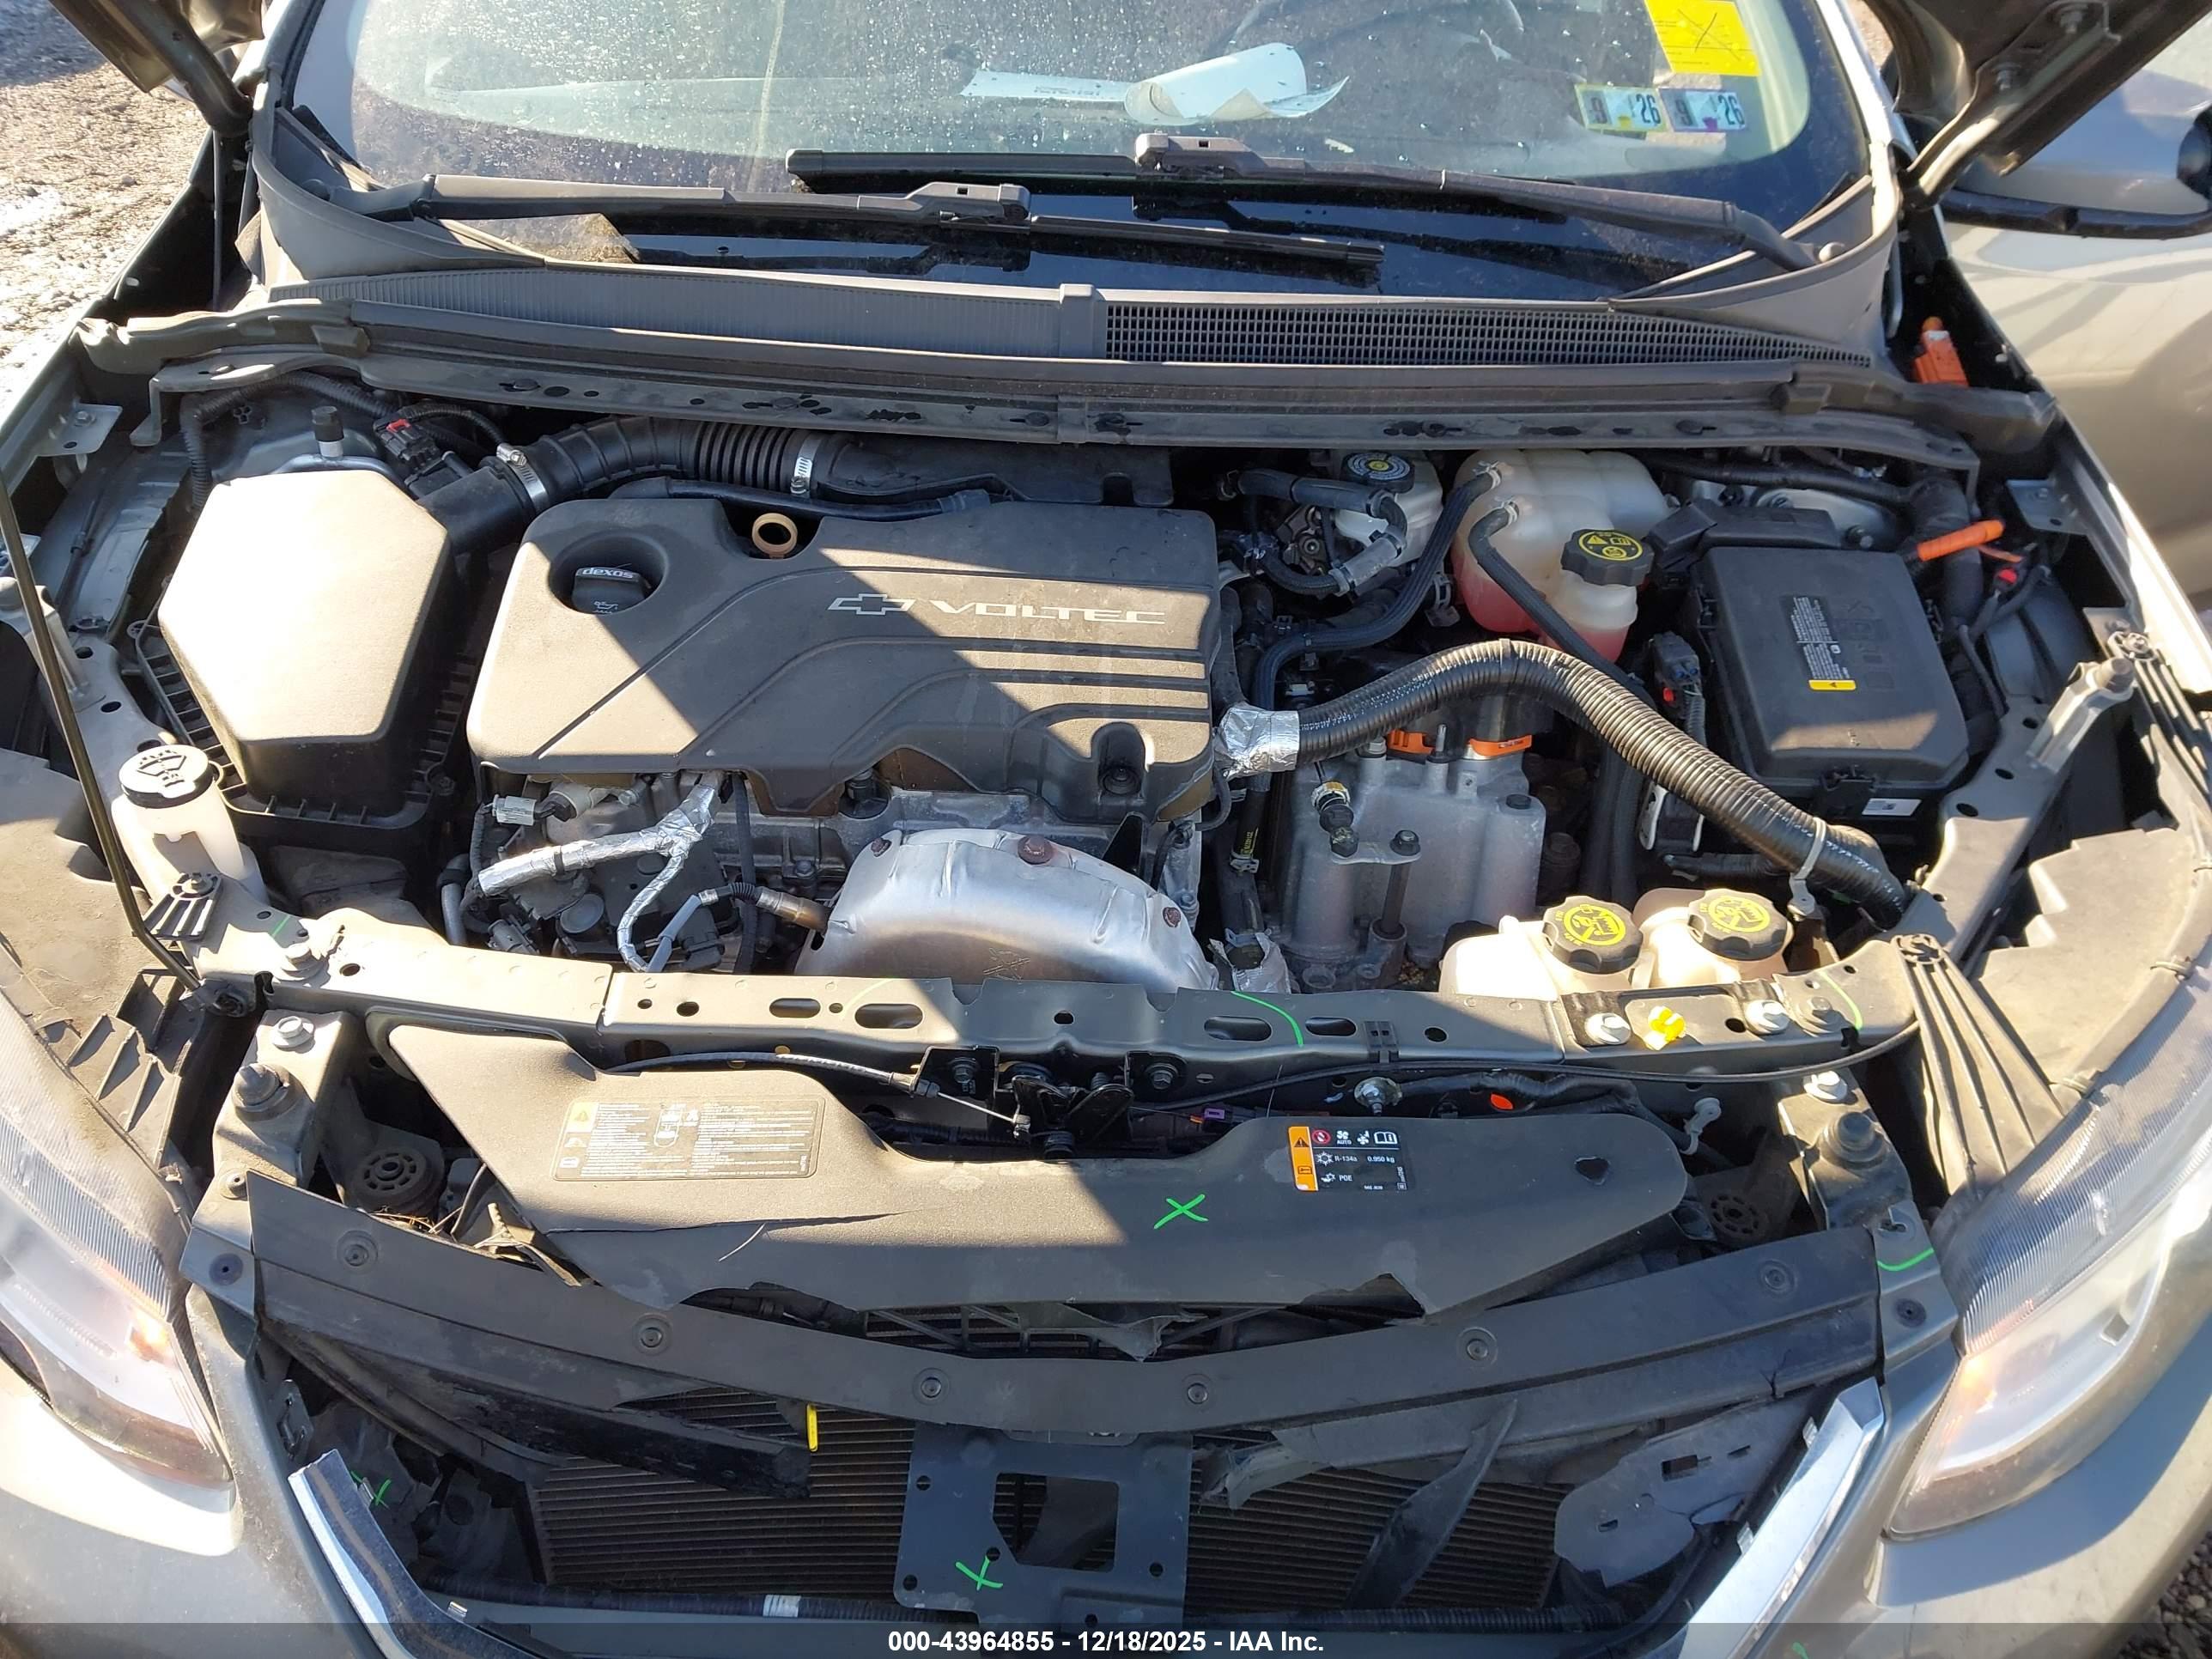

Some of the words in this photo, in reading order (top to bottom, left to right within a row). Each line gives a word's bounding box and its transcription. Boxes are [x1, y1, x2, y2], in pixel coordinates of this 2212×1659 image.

[1636, 93, 1662, 125] 26
[1718, 94, 1745, 125] 26
[582, 567, 634, 579] dexos
[930, 599, 1165, 625] VOLTEC
[1386, 1156, 1395, 1164] kg
